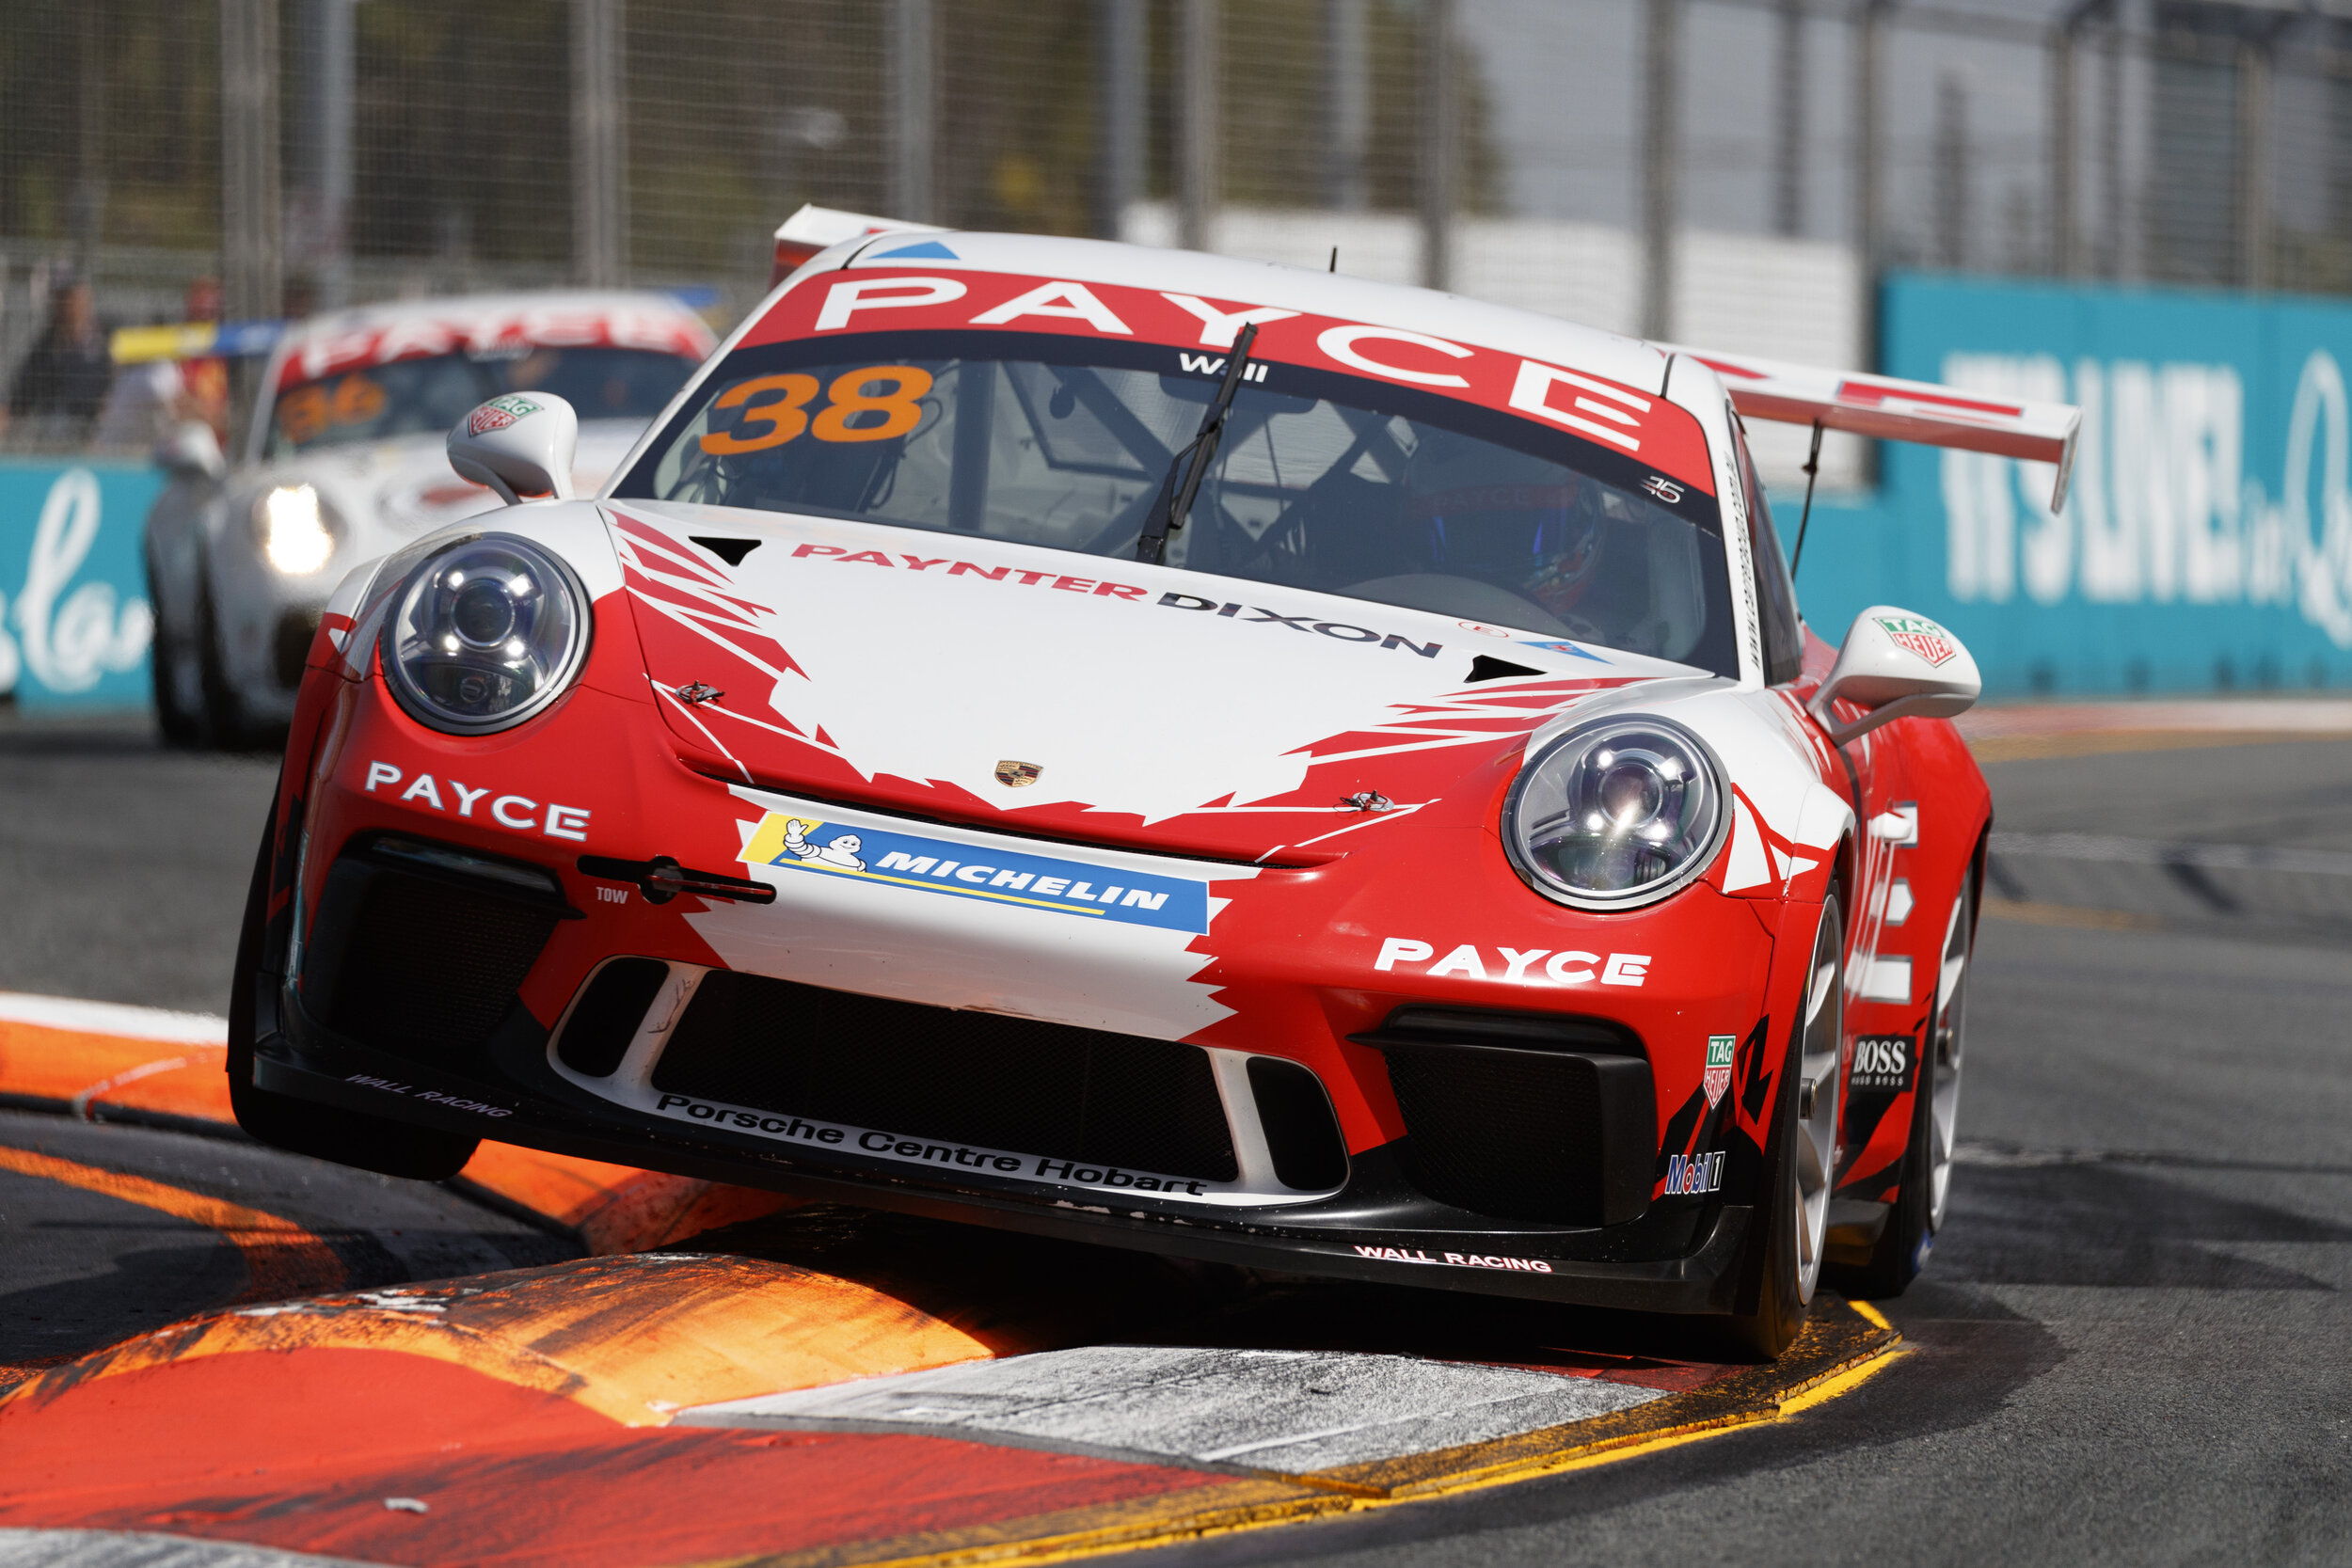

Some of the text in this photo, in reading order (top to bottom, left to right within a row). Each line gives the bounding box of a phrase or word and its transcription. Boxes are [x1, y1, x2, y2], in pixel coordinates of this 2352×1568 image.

[815, 277, 1651, 451] PAYCE
[1180, 352, 1268, 383] Wll
[700, 366, 933, 455] 38
[1880, 618, 1945, 638] TAG
[1894, 633, 1954, 661] HEUER
[364, 760, 591, 842] PAYCE
[596, 886, 628, 905] TOW
[875, 850, 1169, 911] MICHELIN
[1375, 937, 1652, 987] PAYCE
[1711, 1039, 1733, 1063] TAG
[1853, 1039, 1906, 1074] BOSS
[344, 1074, 513, 1117] WALL RACING
[1705, 1069, 1730, 1102] HEUER
[657, 1094, 1207, 1196] Porsche Centre Hobart
[1664, 1152, 1712, 1195] Mobil
[1354, 1245, 1552, 1273] WALL RACING
